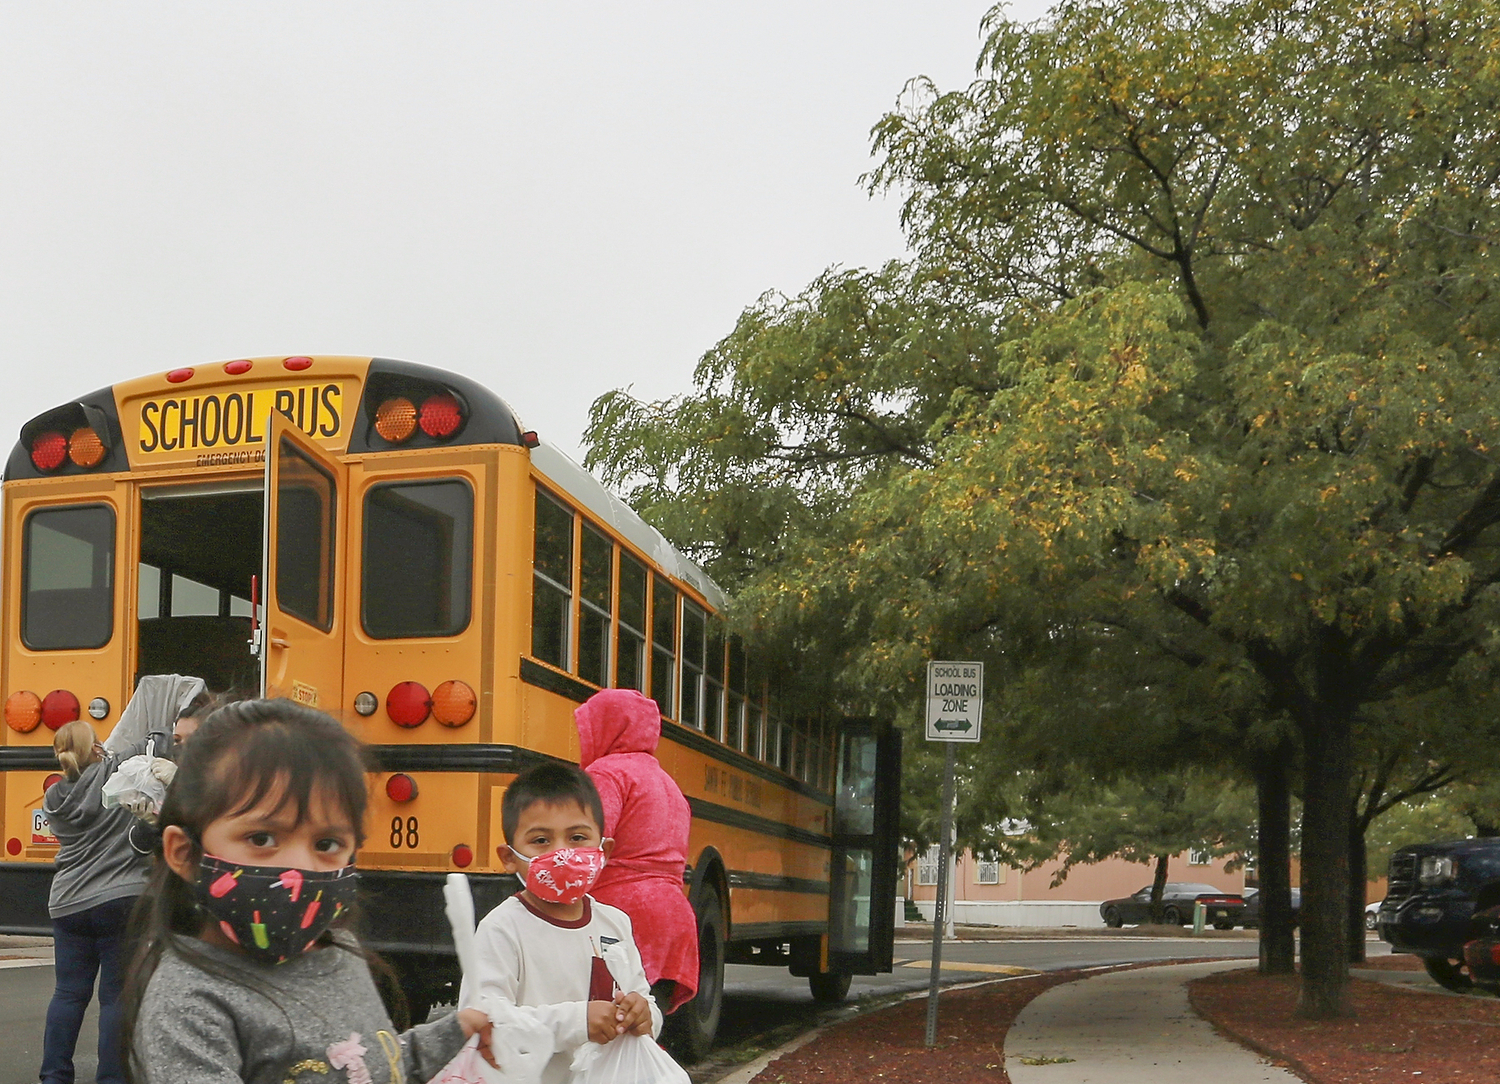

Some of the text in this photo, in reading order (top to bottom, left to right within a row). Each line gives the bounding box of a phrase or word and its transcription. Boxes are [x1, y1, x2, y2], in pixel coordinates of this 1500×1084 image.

[140, 384, 341, 453] SCHOOL BUS
[196, 450, 252, 467] EMERGENCY
[934, 668, 976, 679] SCHOOL BUS
[934, 683, 977, 697] LOADING
[942, 699, 968, 712] ZONE
[390, 816, 419, 849] 88
